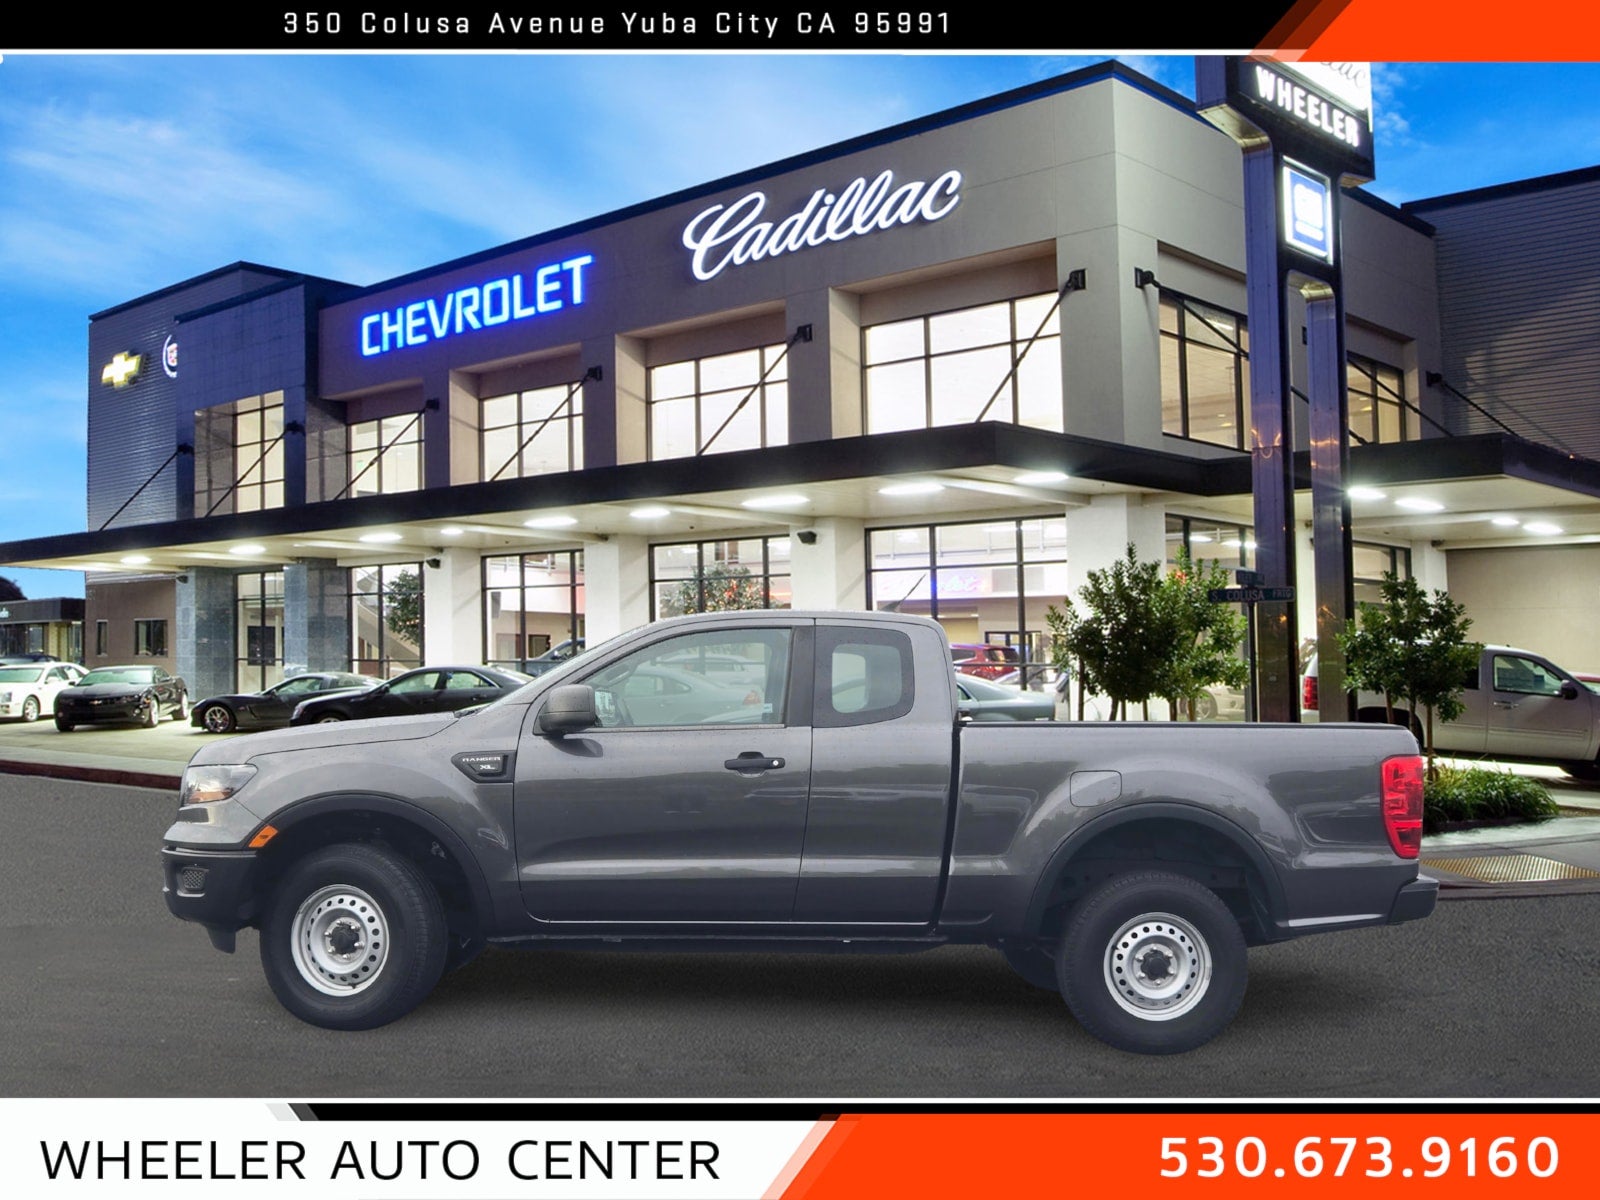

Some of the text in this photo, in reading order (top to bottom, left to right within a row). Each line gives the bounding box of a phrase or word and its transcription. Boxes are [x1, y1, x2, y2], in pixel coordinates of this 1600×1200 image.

[1256, 65, 1360, 147] WHEELER
[682, 169, 962, 281] Cadillac
[361, 254, 594, 357] CHEVROLET
[1226, 589, 1265, 601] COLUSA
